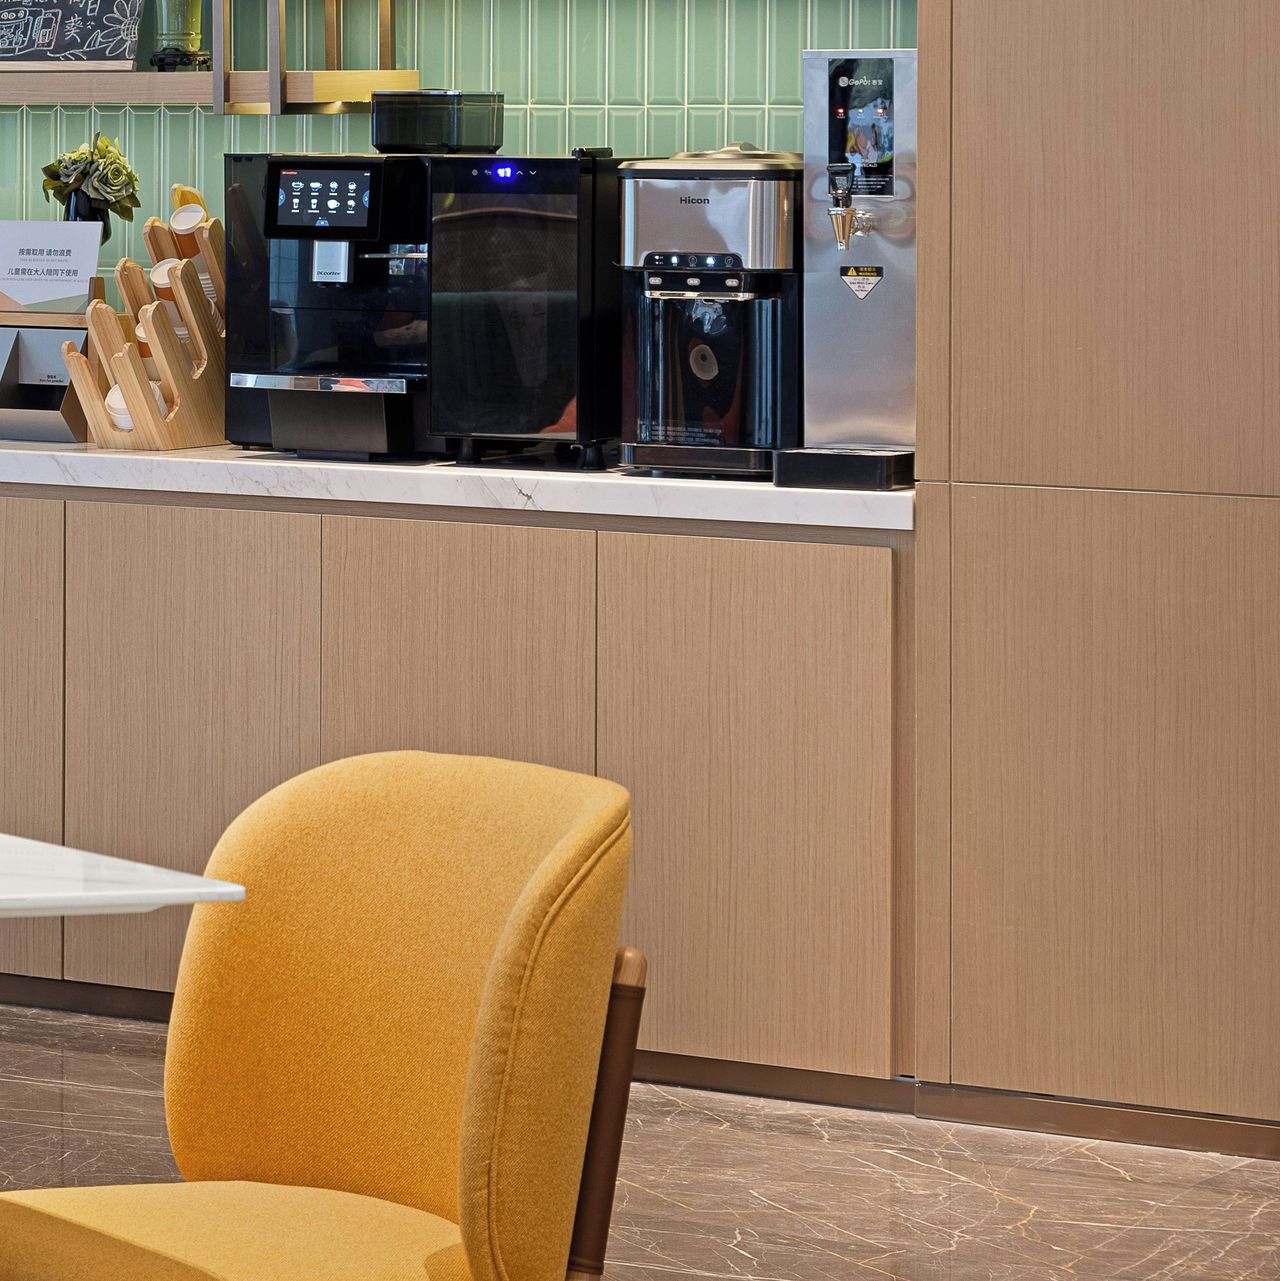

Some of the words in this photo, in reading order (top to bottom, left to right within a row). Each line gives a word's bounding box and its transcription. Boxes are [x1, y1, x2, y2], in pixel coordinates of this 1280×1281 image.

[679, 196, 710, 205] Hicon
[18, 248, 45, 257] 按需取用
[46, 248, 72, 257] 请勿浪费
[7, 268, 79, 277] 儿童需在大人陪同下使用
